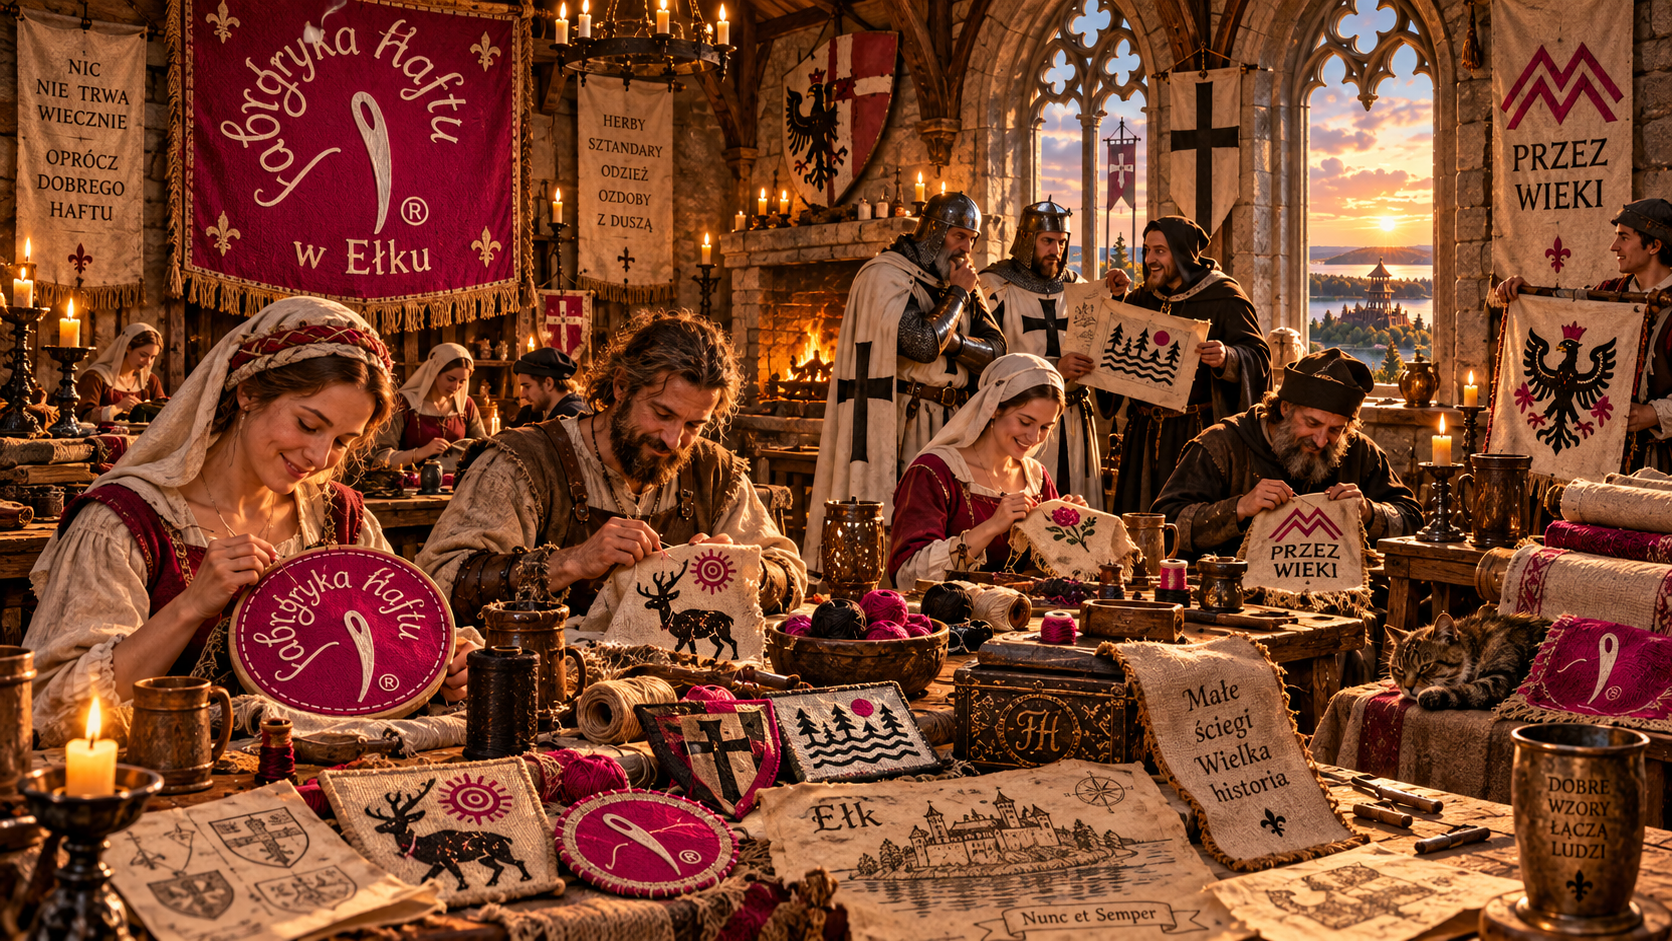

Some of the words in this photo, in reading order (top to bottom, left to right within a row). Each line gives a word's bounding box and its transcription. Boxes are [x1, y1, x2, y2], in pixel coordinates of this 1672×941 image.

[68, 58, 101, 77] NIC
[36, 78, 69, 98] NIE
[77, 85, 129, 105] TRWA
[374, 19, 467, 144] Haftu
[37, 105, 127, 130] WIECZNIE
[603, 114, 646, 131] HERBY
[588, 137, 663, 158] SZTANDARY
[1512, 138, 1609, 172] PRZEZ
[46, 149, 118, 170] OPRÓCZ
[601, 164, 649, 181] ODZIEŻ
[37, 174, 125, 196] DOBREGO
[1515, 179, 1604, 211] WIEKI
[598, 189, 651, 206] OZDOBY
[50, 201, 113, 221] HAFTU
[597, 213, 606, 226] Z
[610, 214, 653, 233] DUSZĄ
[293, 241, 327, 269] w
[345, 238, 432, 275] Ełku
[1271, 543, 1340, 560] PRZEZ
[1273, 562, 1338, 578] WIEKI
[1182, 679, 1240, 712] Małe
[1195, 708, 1253, 742] ściegi
[1194, 742, 1272, 775] Wielka
[1209, 770, 1290, 802] historia
[1548, 776, 1610, 795] DOBRE
[811, 801, 883, 834] Ełk
[1548, 798, 1611, 817] WZORY
[1550, 820, 1608, 841] ŁĄCZĄ
[1551, 841, 1605, 859] LUDZI
[1020, 911, 1068, 925] Nunc
[1074, 910, 1091, 922] et
[1095, 907, 1157, 924] Semper
